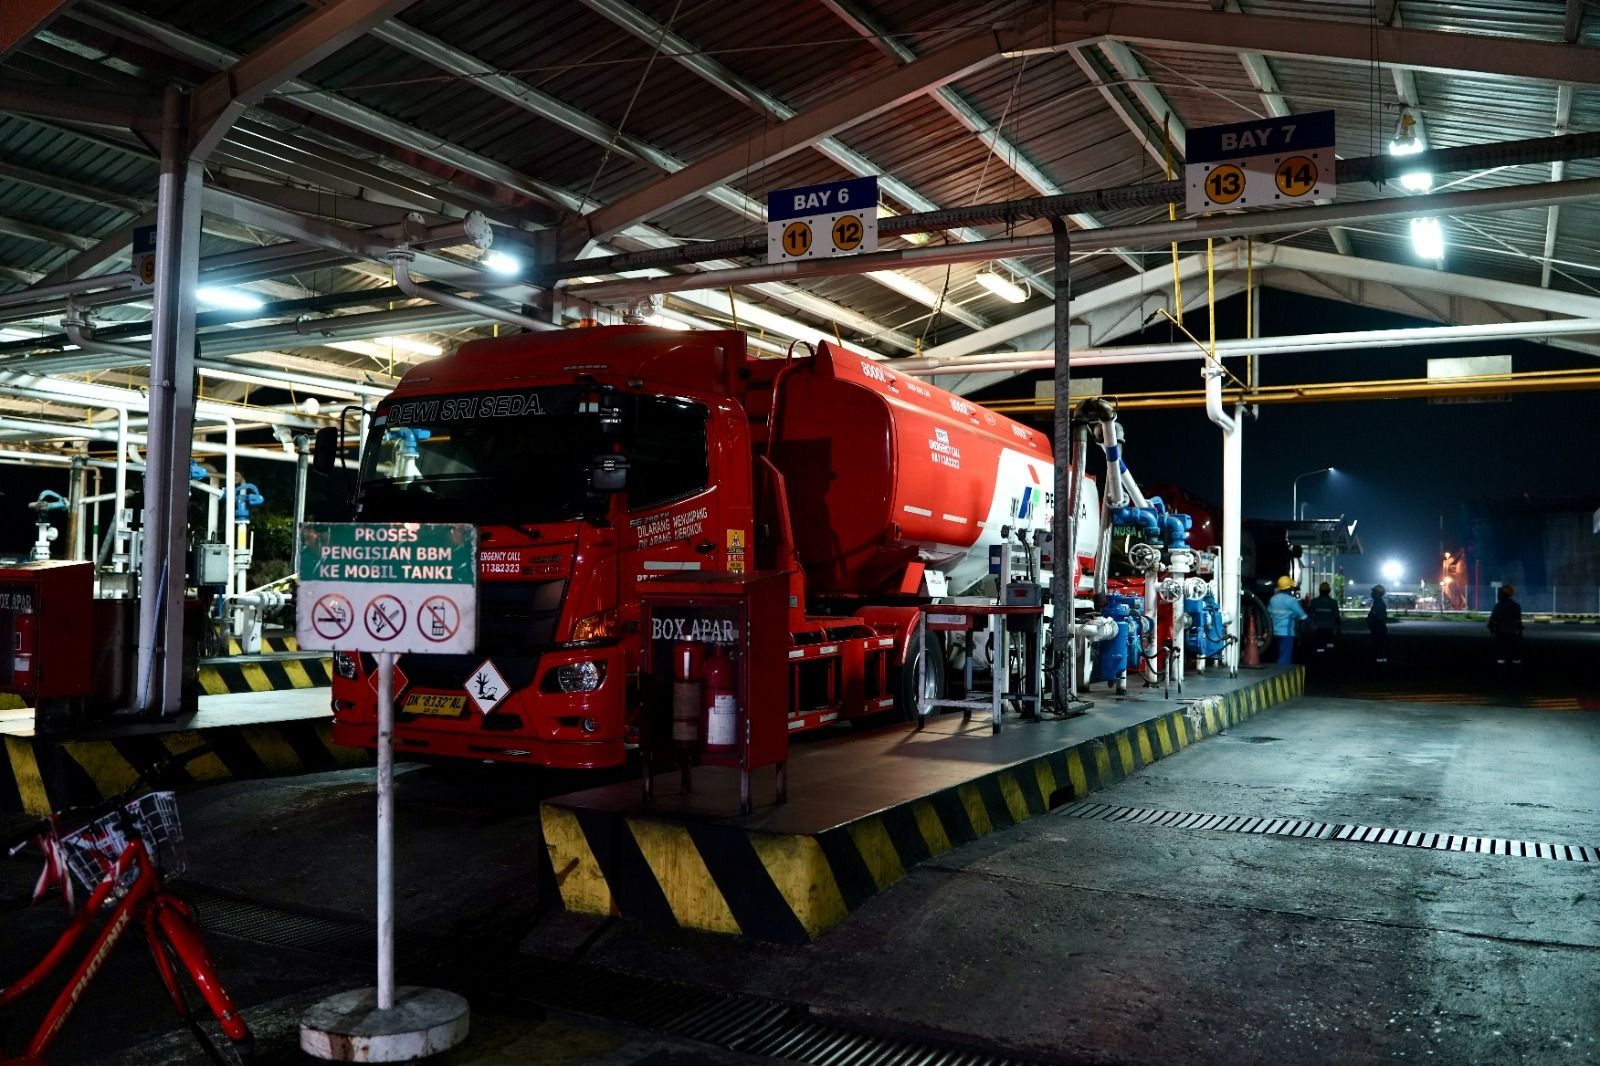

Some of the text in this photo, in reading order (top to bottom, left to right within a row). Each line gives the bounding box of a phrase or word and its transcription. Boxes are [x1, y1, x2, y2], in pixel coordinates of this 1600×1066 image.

[1221, 124, 1296, 151] BAY 7
[1210, 173, 1241, 196] 13
[1280, 163, 1312, 189] 14
[794, 188, 849, 211] BAY 6
[788, 229, 807, 249] 11
[836, 223, 860, 243] 12
[388, 400, 438, 426] DEWI
[441, 397, 478, 421] SRI
[354, 527, 418, 542] PROSES
[637, 518, 670, 538] DILARANG
[1113, 526, 1137, 537] NUSA
[321, 545, 452, 561] PENGISIAN BBM
[480, 551, 521, 561] ERGENCY CALL
[319, 564, 454, 580] KE MOBIL TANKI
[481, 563, 520, 573] 11382323
[0, 593, 32, 609] OX APAR
[651, 617, 735, 642] BOX APAR
[71, 908, 130, 1001] PHOENIX
